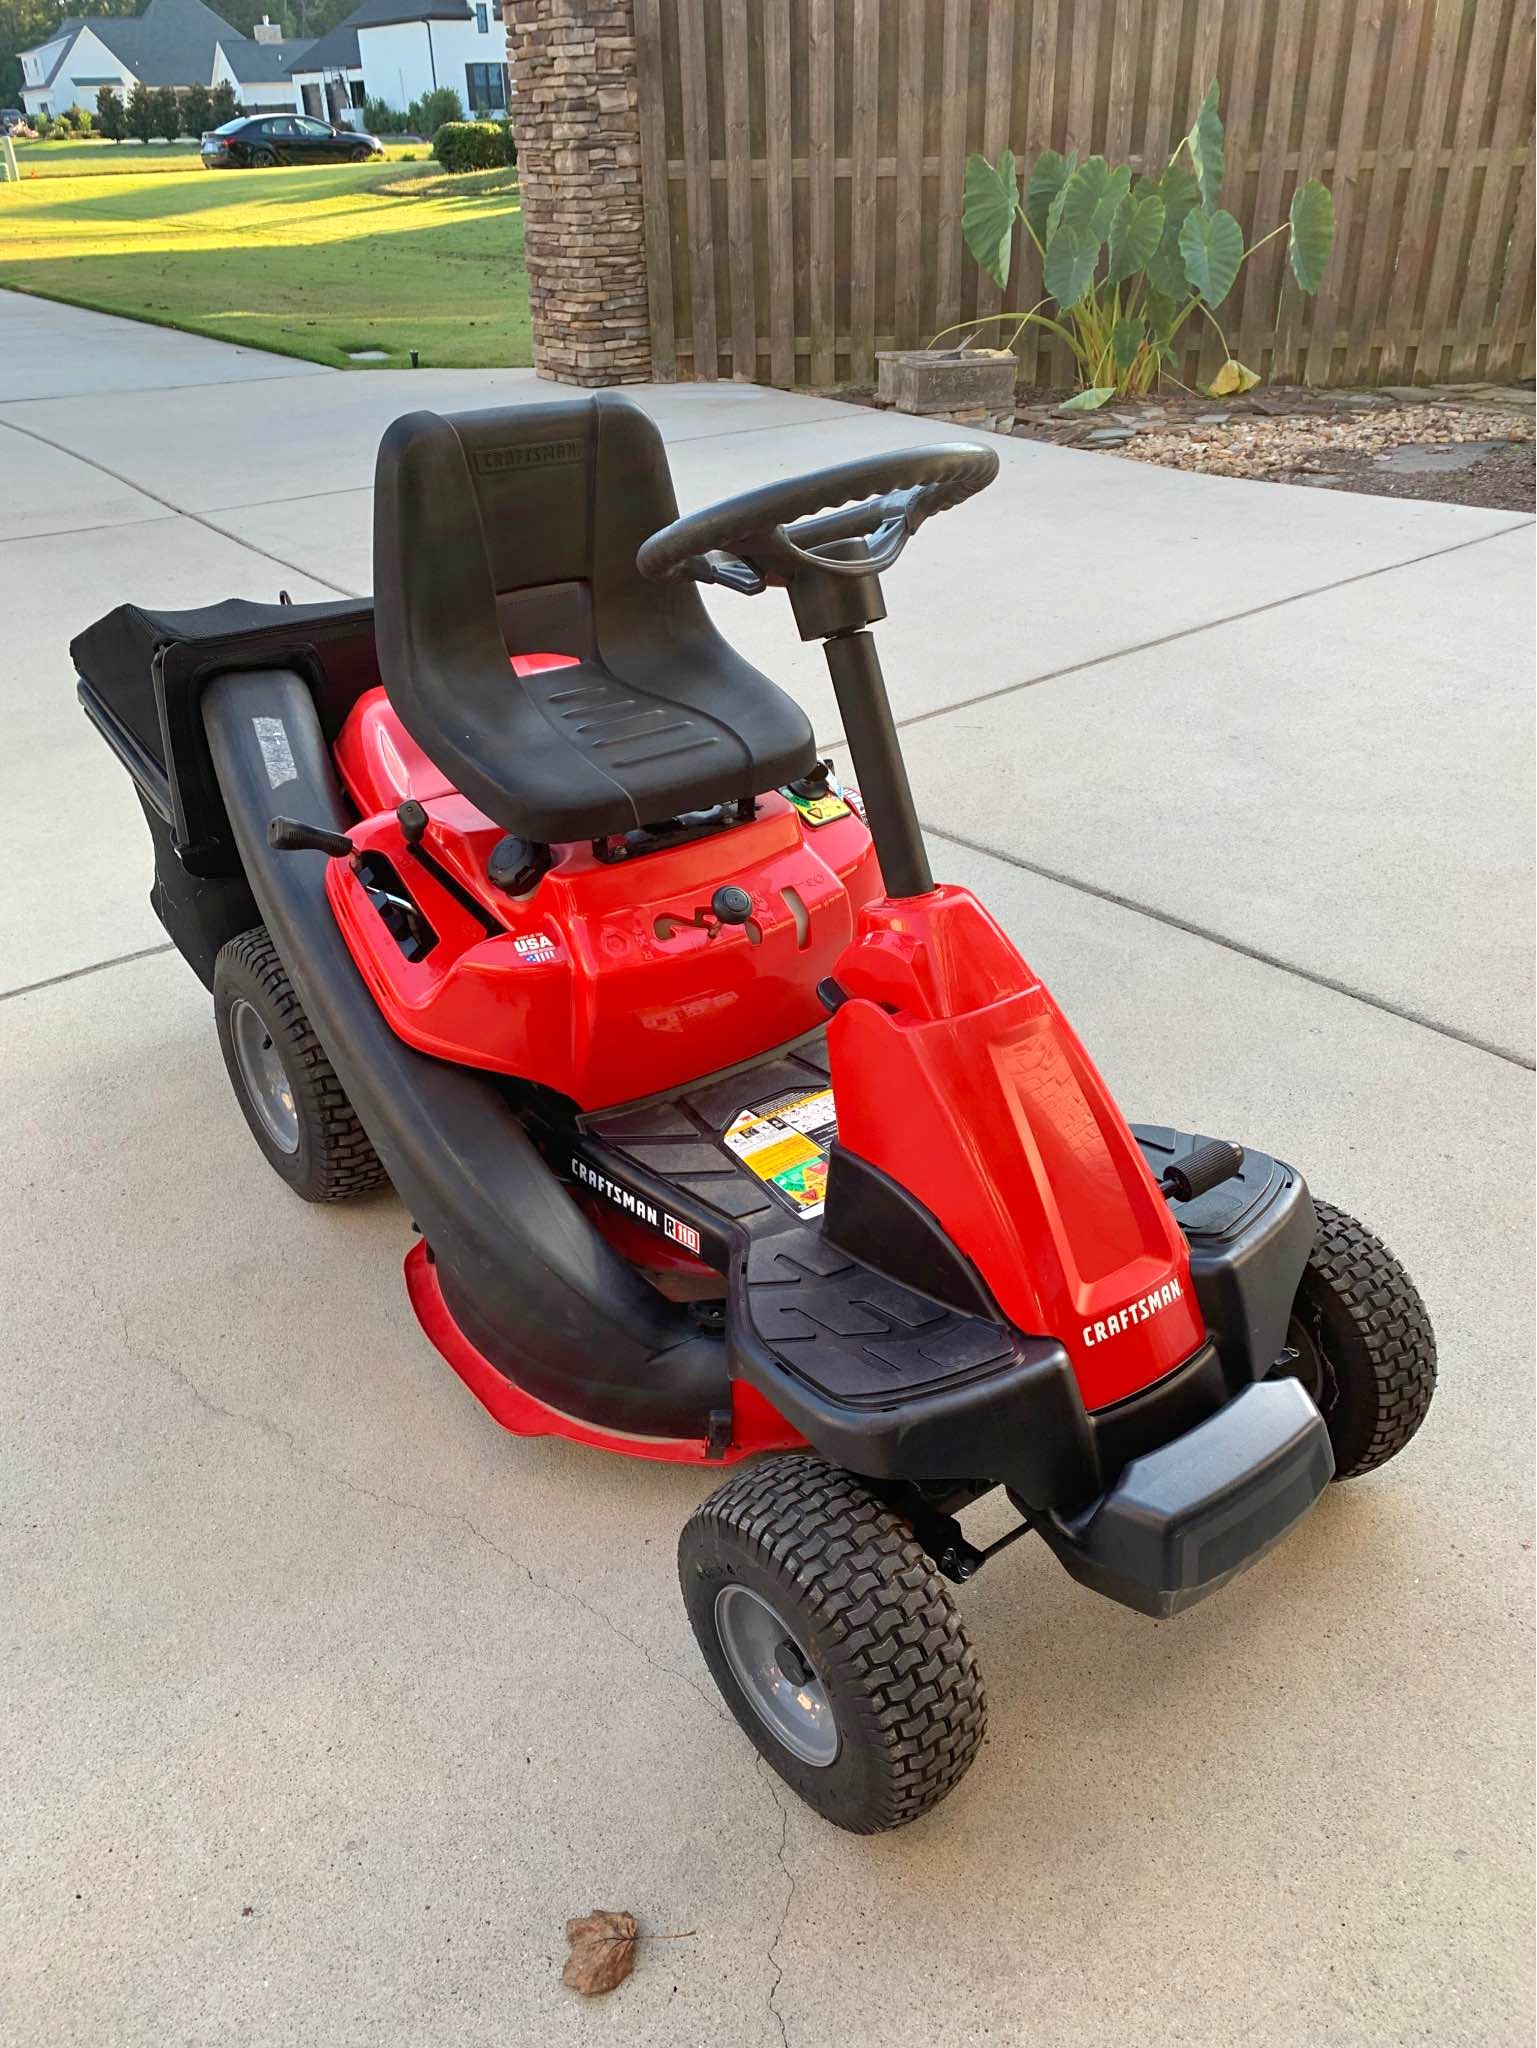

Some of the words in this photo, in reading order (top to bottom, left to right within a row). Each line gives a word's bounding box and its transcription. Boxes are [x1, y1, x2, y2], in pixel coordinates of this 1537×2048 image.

[513, 935, 554, 953] USA
[571, 1158, 657, 1226] CRAFTSMAN
[1082, 1278, 1181, 1347] CRAFTSMAN
